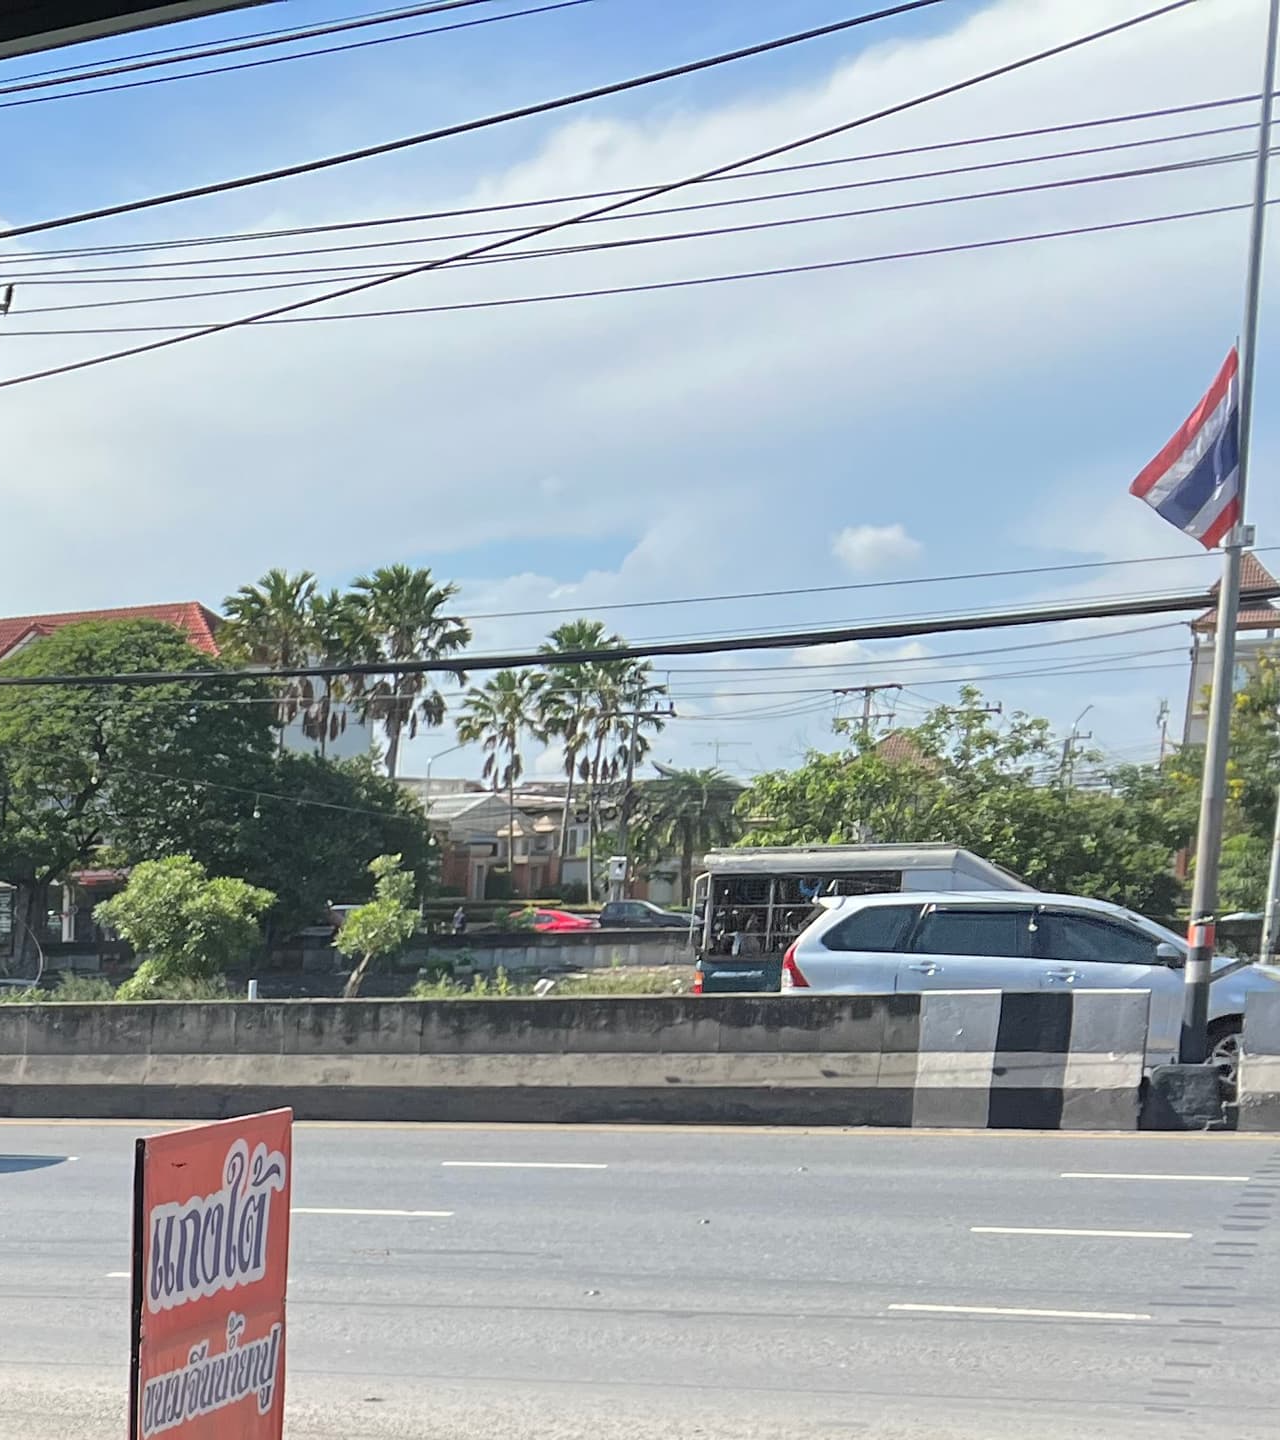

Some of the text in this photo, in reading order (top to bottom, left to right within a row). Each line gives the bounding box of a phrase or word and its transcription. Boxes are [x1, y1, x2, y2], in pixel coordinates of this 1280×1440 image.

[151, 1150, 282, 1300] แกงใต้
[144, 1315, 281, 1433] ขนมจีนน้ำยาปู
